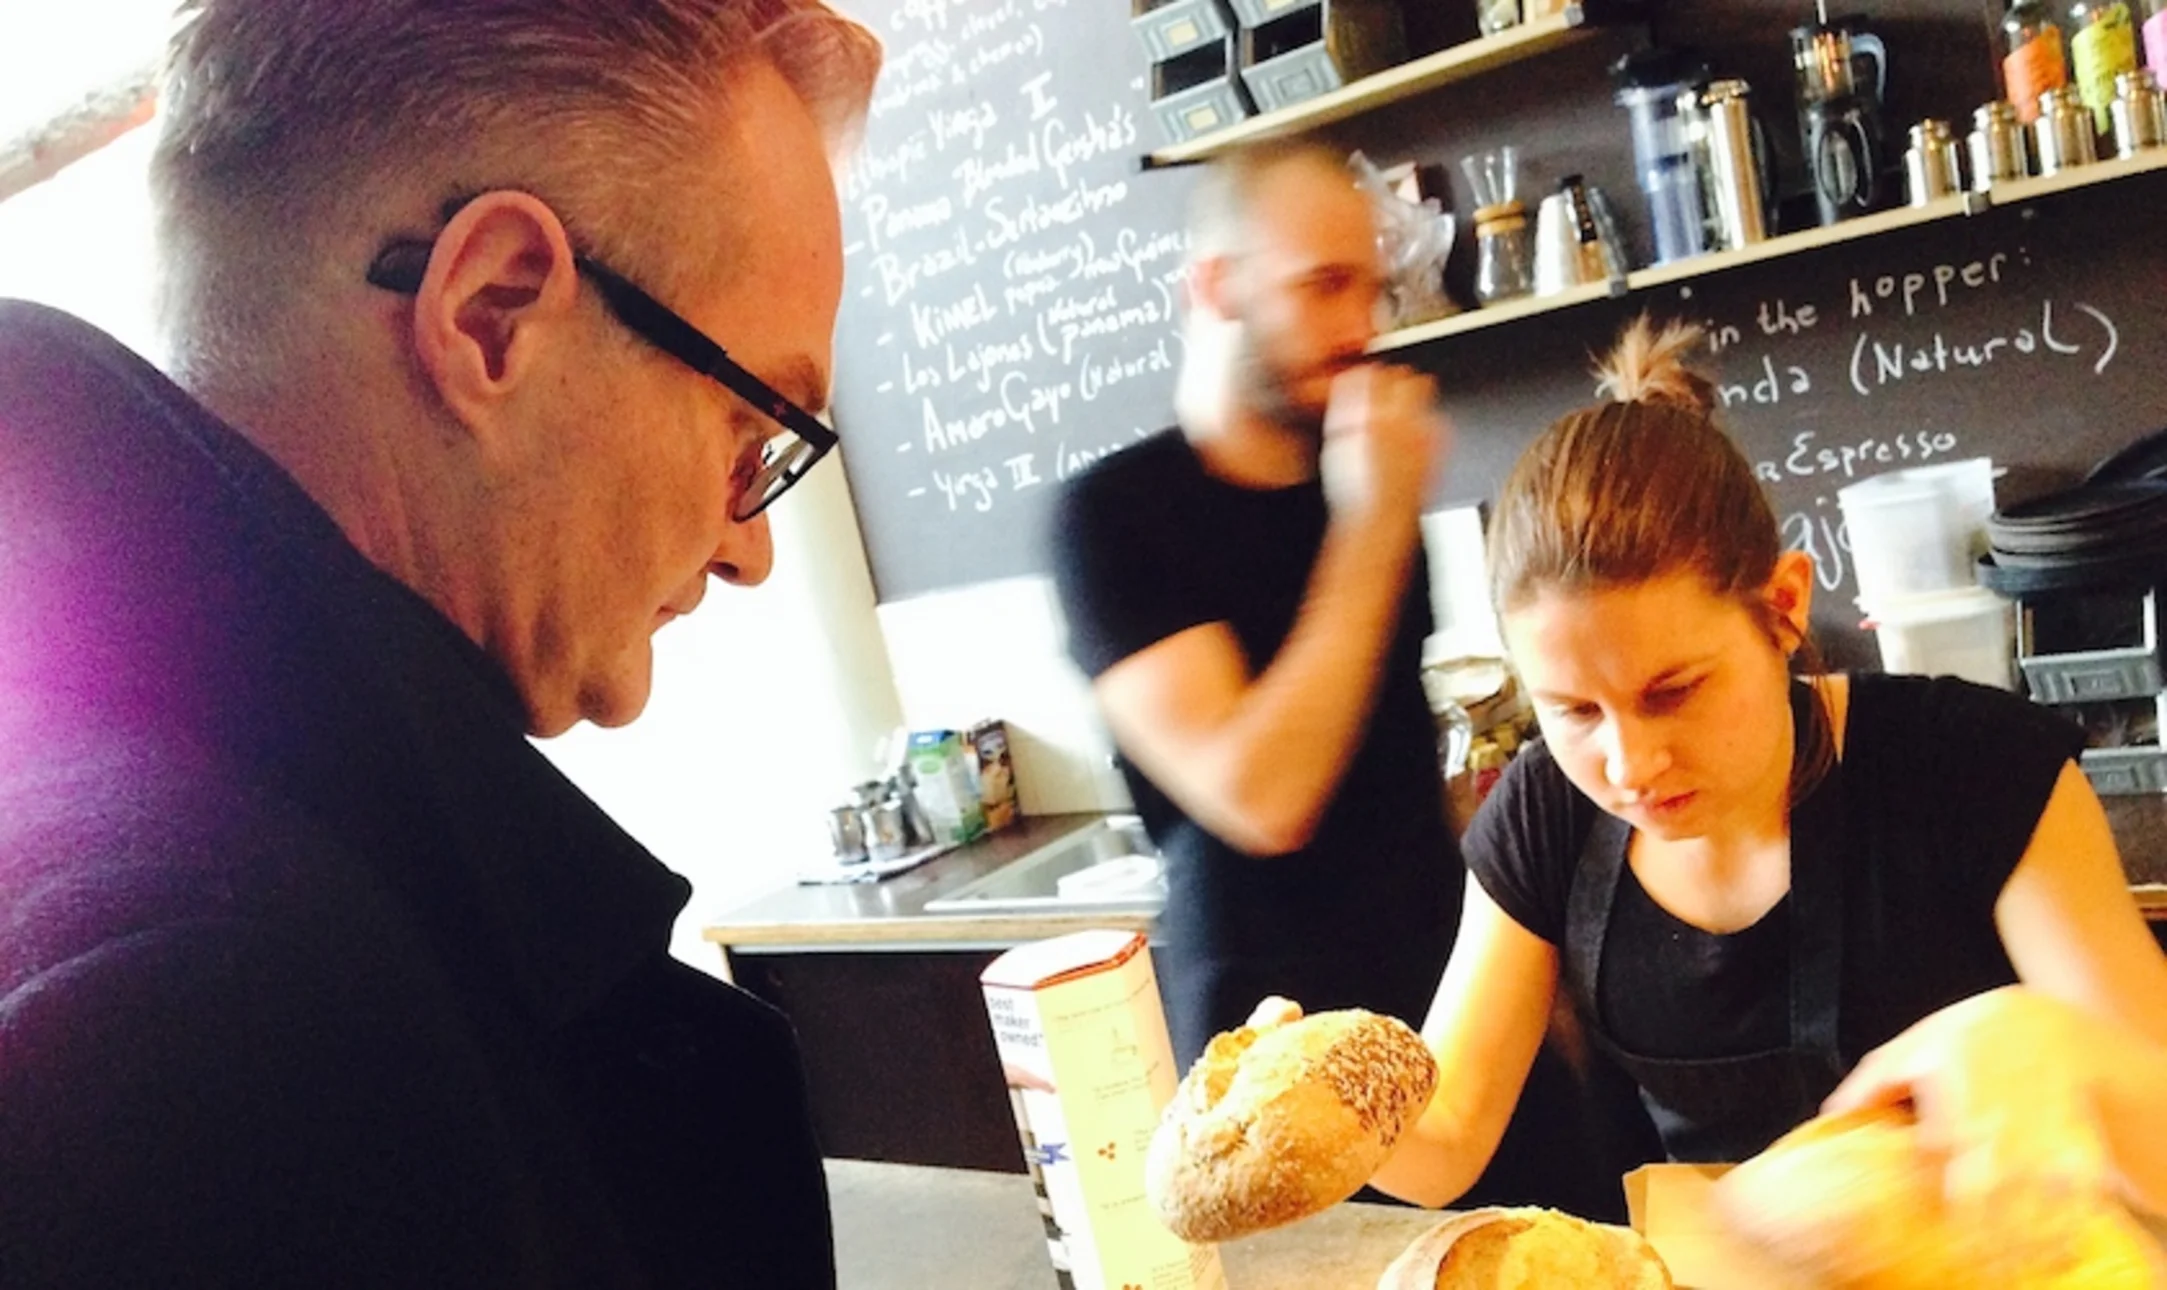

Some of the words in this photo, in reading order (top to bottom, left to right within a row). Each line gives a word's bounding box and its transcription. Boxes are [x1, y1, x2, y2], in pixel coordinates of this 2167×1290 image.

[1706, 318, 1740, 354] in
[1757, 299, 1818, 335] the
[1850, 247, 2031, 319] hopper:
[1716, 354, 1812, 407] nda
